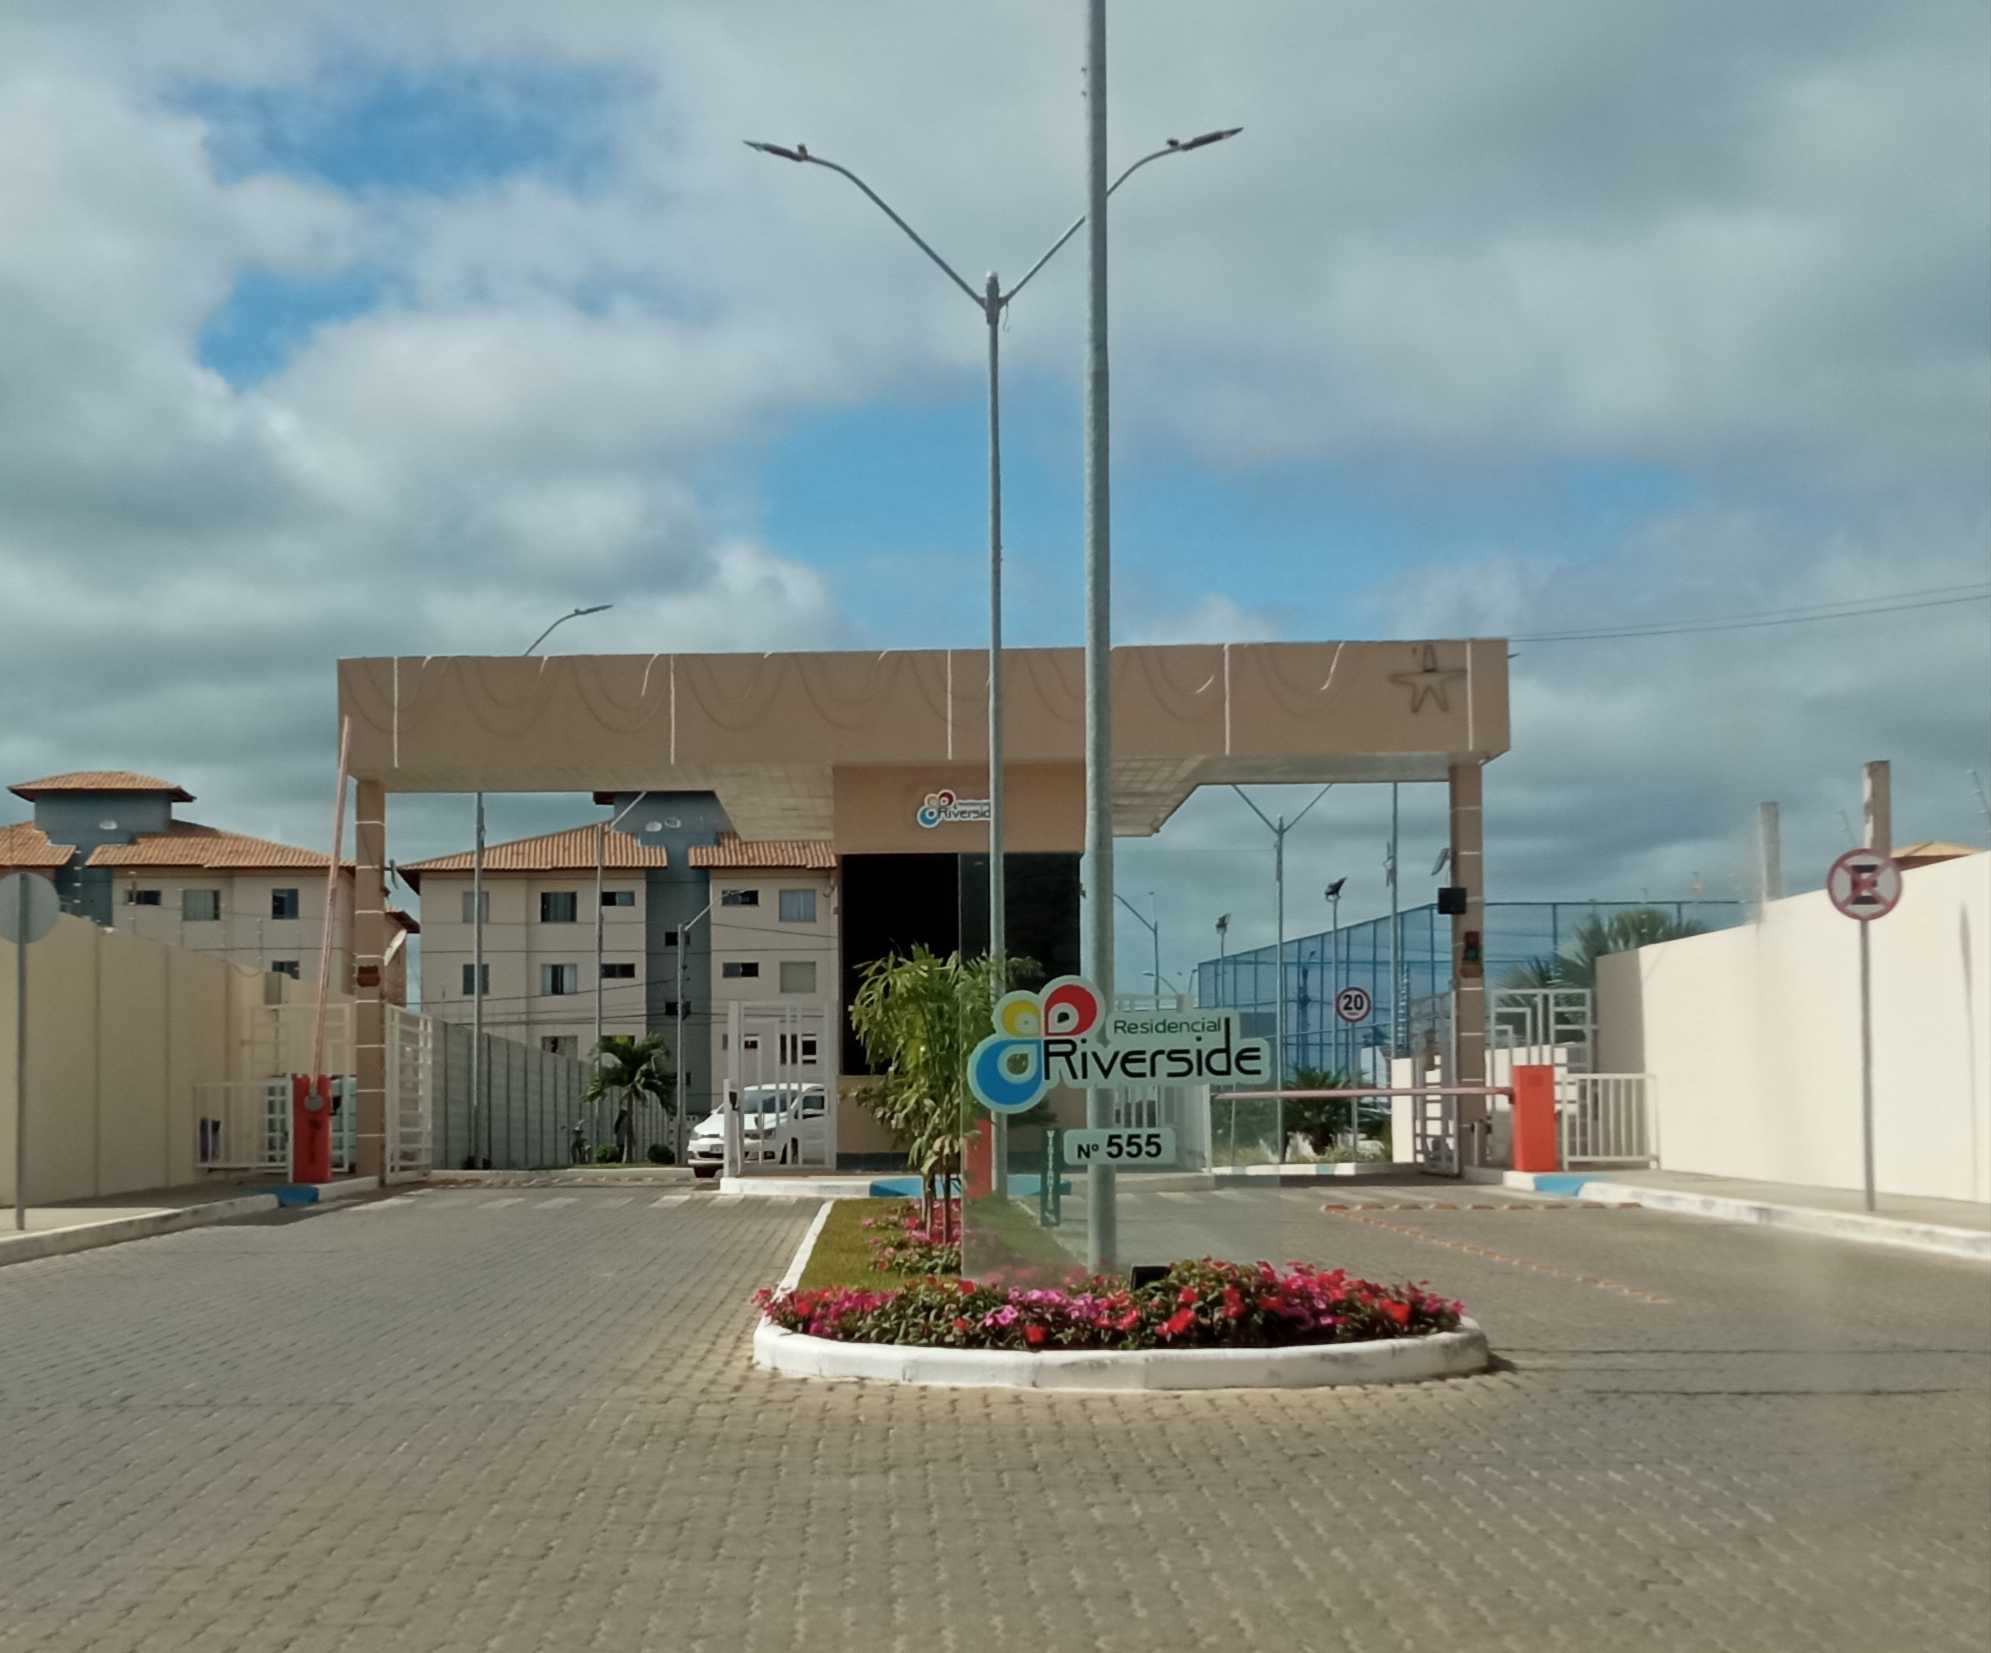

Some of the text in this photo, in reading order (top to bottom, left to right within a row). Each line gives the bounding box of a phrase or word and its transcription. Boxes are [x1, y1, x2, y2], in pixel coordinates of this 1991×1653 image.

[938, 804, 992, 819] Riversid
[1343, 994, 1364, 1011] 20
[1113, 1017, 1221, 1035] Residencial
[1044, 1017, 1261, 1080] Riverside
[1106, 1133, 1162, 1158] 555
